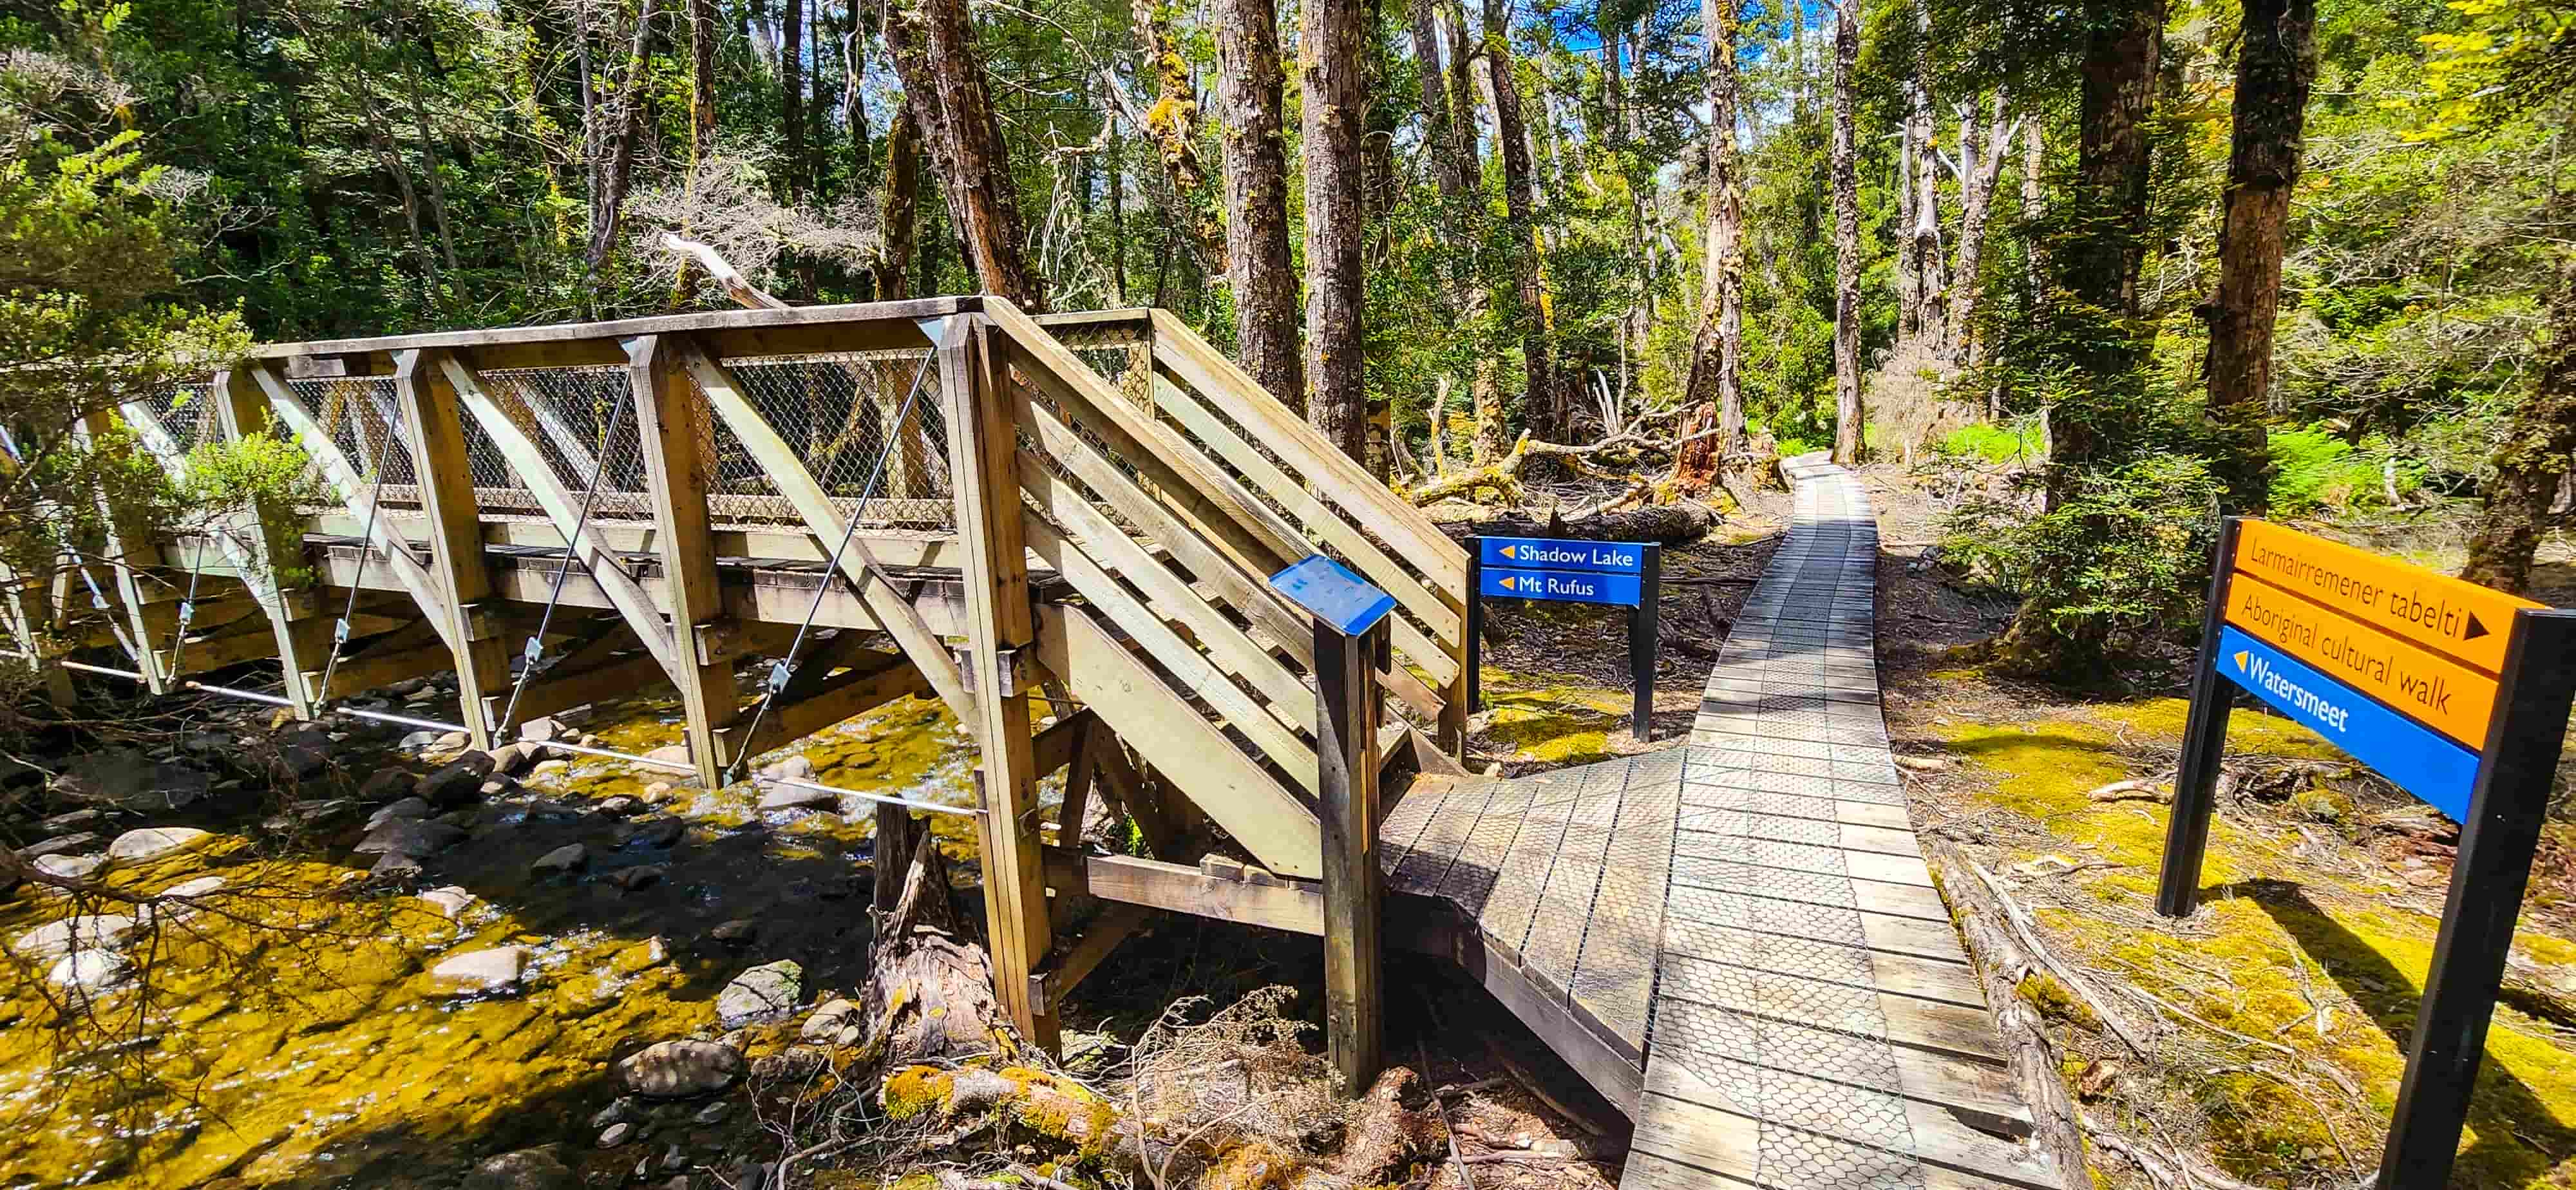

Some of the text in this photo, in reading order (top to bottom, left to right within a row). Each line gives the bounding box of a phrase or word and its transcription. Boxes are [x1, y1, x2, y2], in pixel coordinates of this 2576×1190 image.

[1519, 576, 1594, 595] Mt Rufus
[1520, 545, 1633, 566] Shadow Lake
[2251, 536, 2461, 638] Larmairremener tabelti
[2242, 594, 2451, 715] Aboriginal cultural walk
[2250, 652, 2349, 732] Watersmeet
